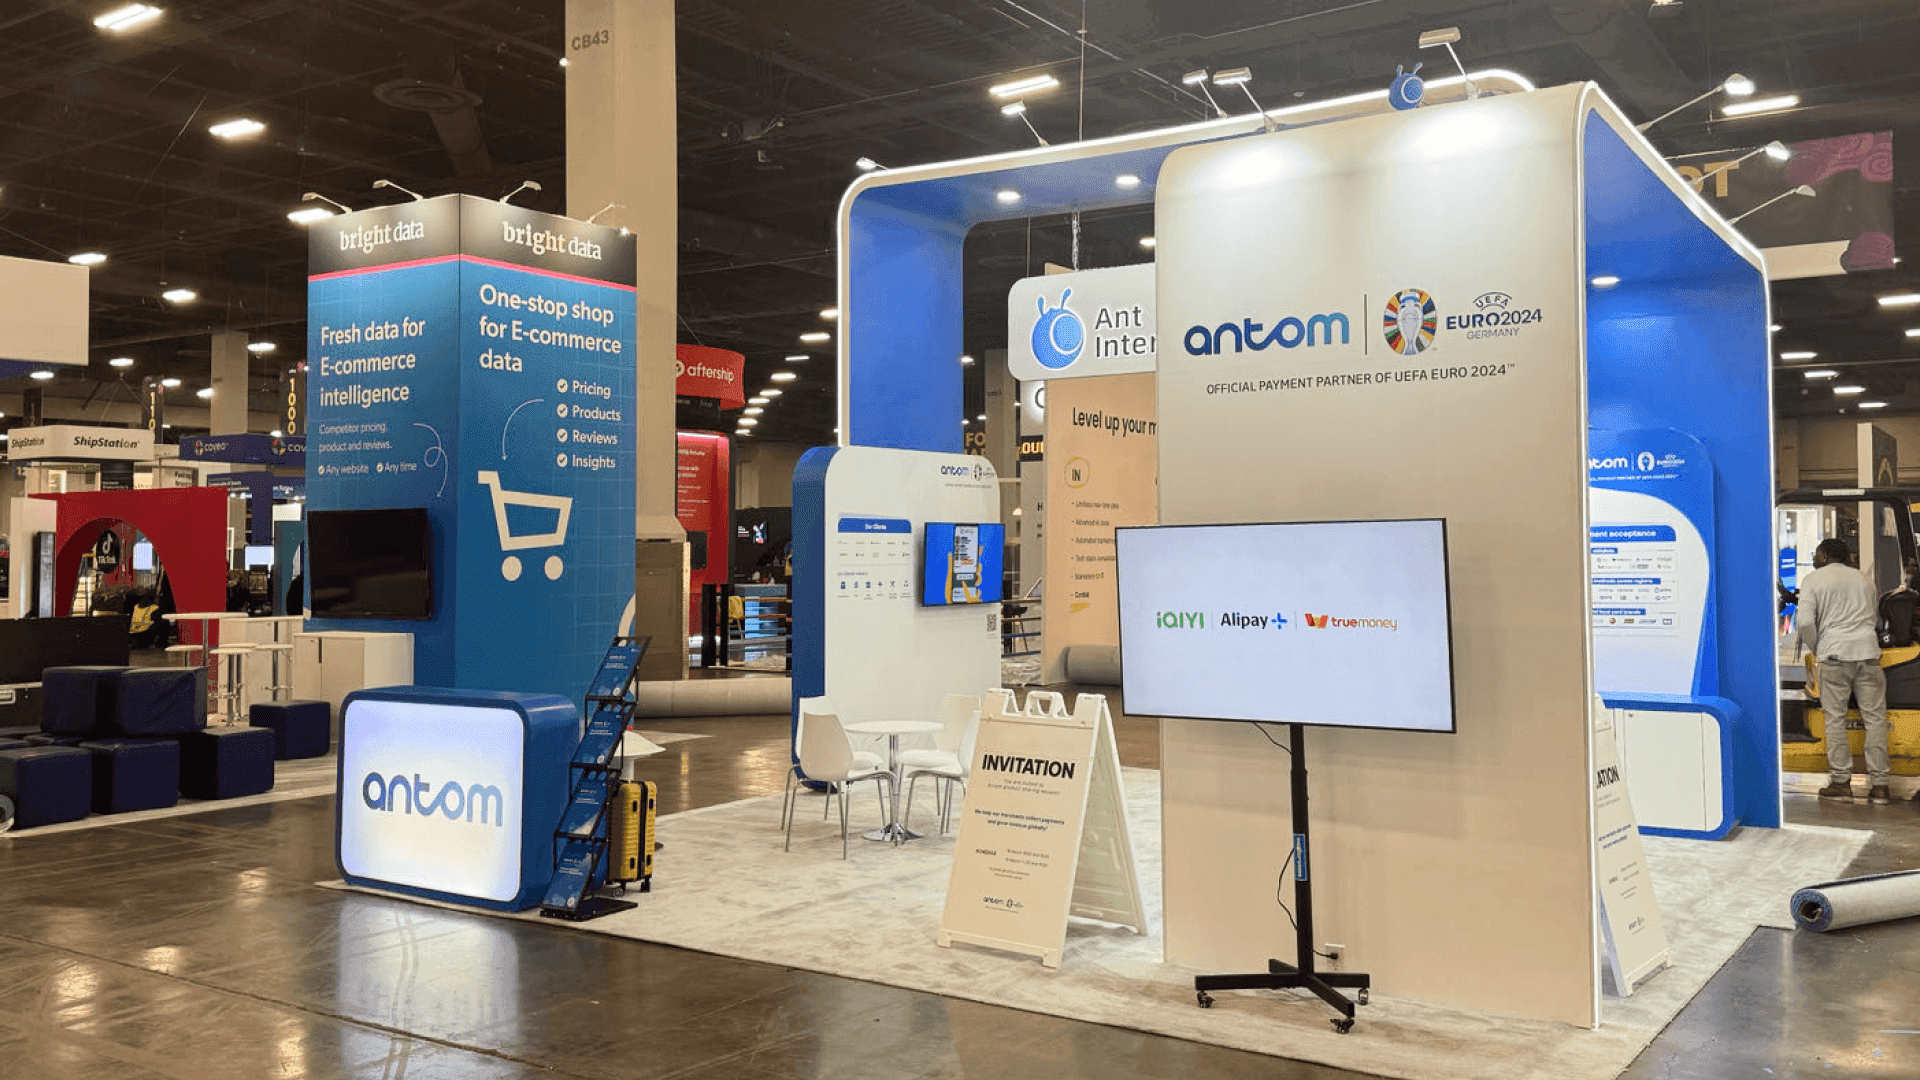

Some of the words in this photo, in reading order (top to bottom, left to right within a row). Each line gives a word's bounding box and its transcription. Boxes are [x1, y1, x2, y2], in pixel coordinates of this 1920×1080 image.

[571, 29, 609, 51] CB43
[340, 222, 391, 254] bright
[393, 220, 424, 241] data
[503, 222, 566, 255] bright
[568, 237, 602, 260] data
[479, 283, 568, 320] One-stop
[571, 300, 614, 326] shop
[1475, 294, 1509, 309] UEFA
[1095, 306, 1142, 329] Ant
[320, 322, 361, 346] Fresh
[364, 321, 399, 342] data
[402, 316, 426, 337] for
[479, 315, 507, 339] for
[511, 321, 622, 354] E-commerce
[1184, 313, 1349, 355] antom
[1467, 327, 1520, 340] GERMANY
[320, 353, 416, 376] E-commerce
[480, 348, 523, 373] data
[687, 362, 735, 385] aftership
[1206, 380, 1256, 395] OFFICIAL
[1259, 376, 1314, 392] PAYMENT
[1316, 373, 1372, 388] PARTNER
[1374, 371, 1392, 386] OF
[1394, 369, 1428, 383] UEFA
[1431, 366, 1468, 381] EURO
[320, 384, 410, 408] intelligence
[572, 380, 611, 400] Pricing
[572, 405, 621, 421] Products
[1073, 406, 1102, 429] Level
[1105, 415, 1120, 437] up
[1122, 417, 1146, 438] your
[572, 429, 618, 445] Reviews
[572, 454, 616, 471] Insights
[1331, 616, 1397, 631] truemoney
[982, 754, 1075, 778] INVITATION
[363, 771, 502, 827] antom
